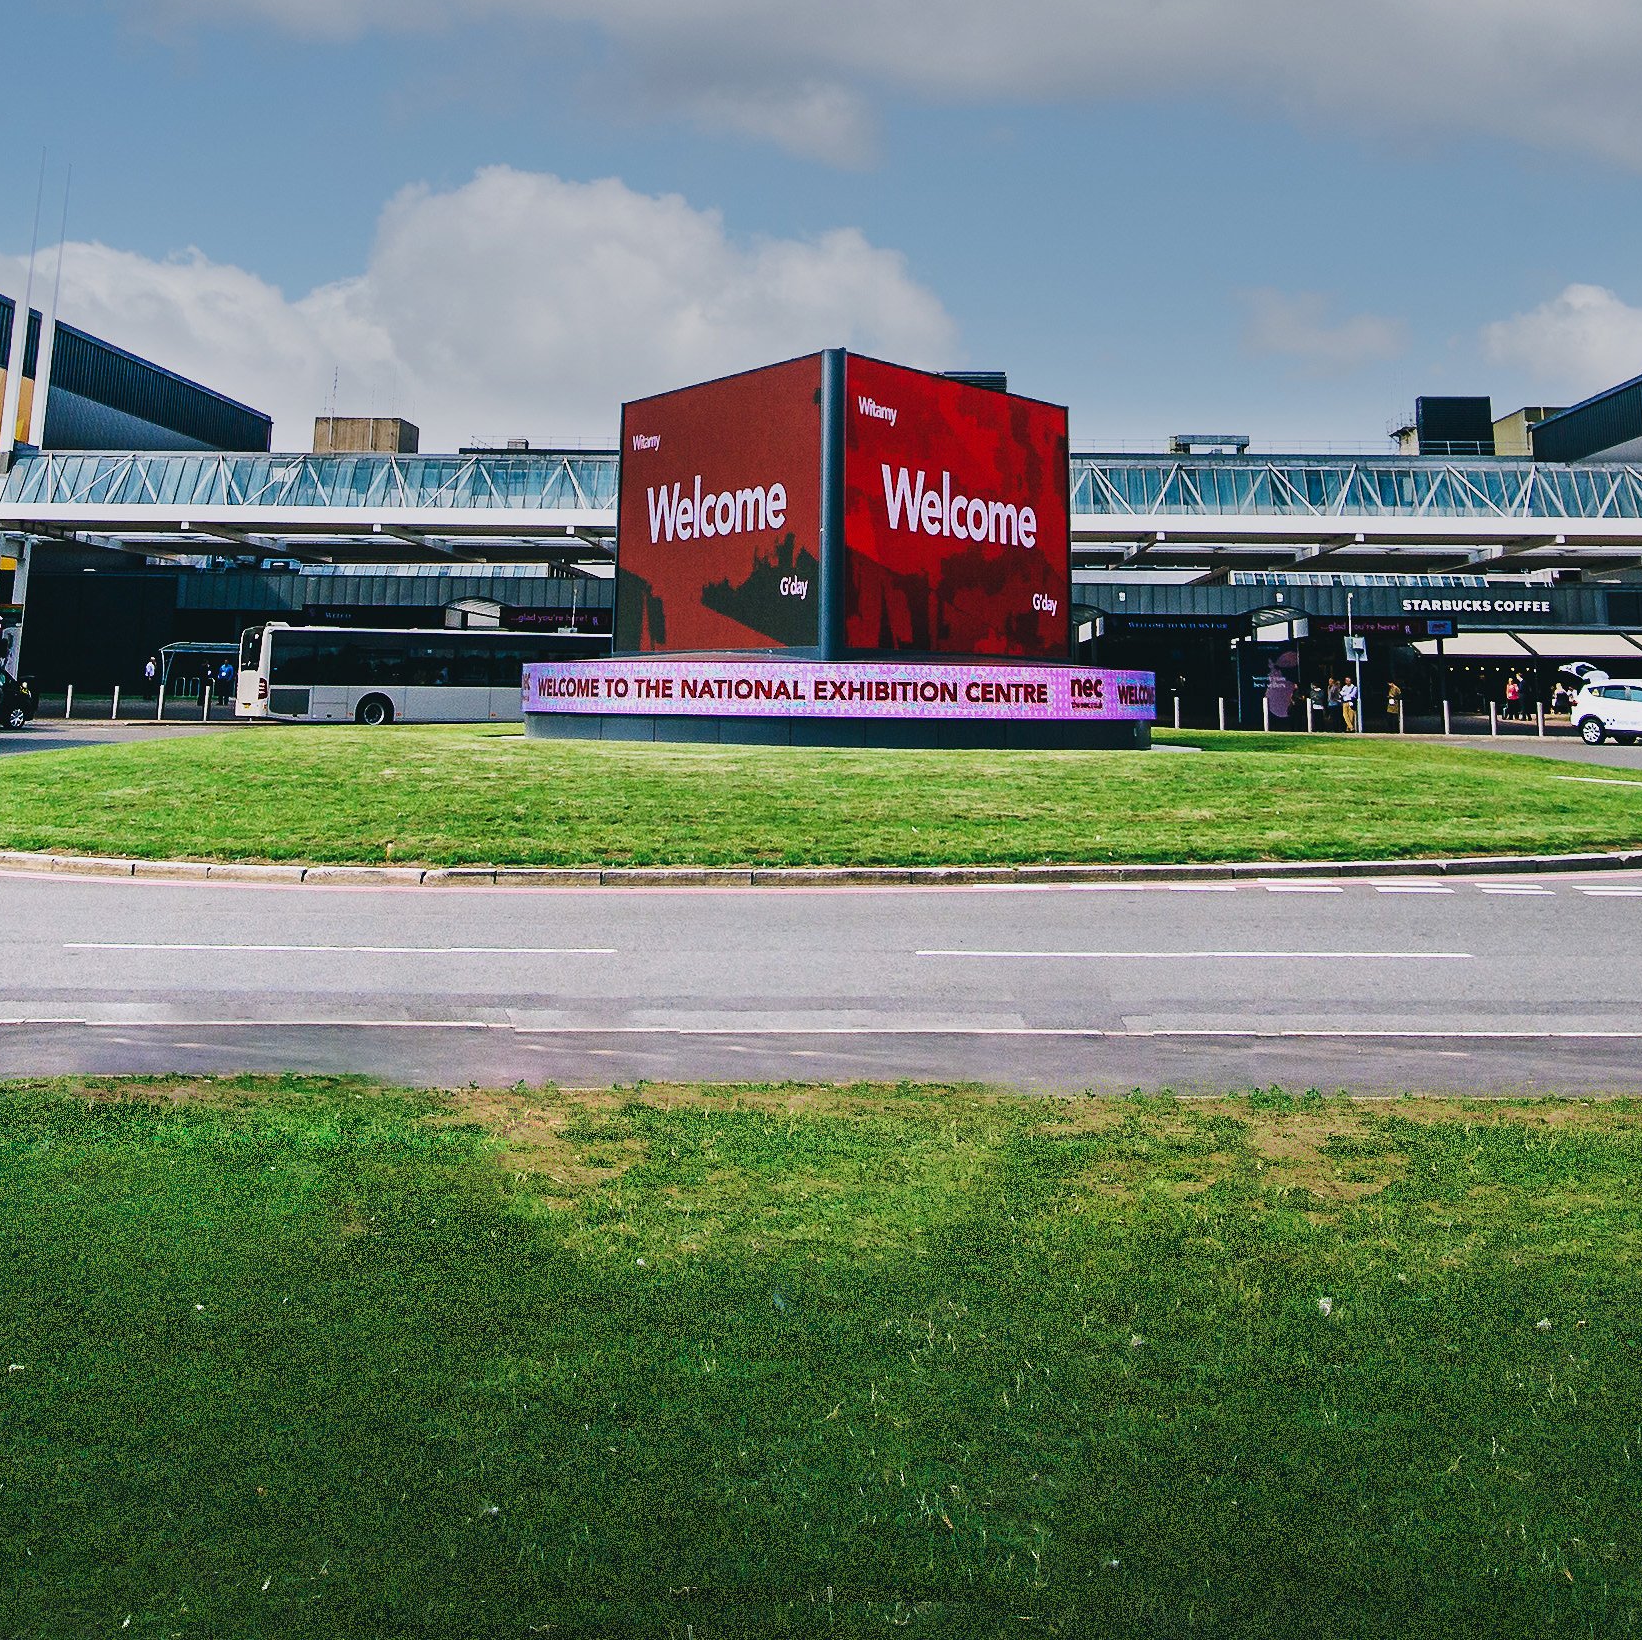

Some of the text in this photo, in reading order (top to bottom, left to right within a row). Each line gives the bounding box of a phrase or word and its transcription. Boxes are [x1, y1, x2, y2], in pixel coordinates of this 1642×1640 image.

[858, 396, 897, 427] Witamy
[632, 434, 661, 451] Witamy
[647, 475, 787, 544] Welcome
[882, 463, 1037, 548] Welcome
[779, 575, 808, 599] G'day
[1033, 593, 1058, 617] G'day
[1402, 599, 1550, 612] STARBUCKS COFFEE
[538, 677, 599, 697] WELCOME
[605, 678, 629, 698] TO
[634, 678, 673, 698] THE
[681, 679, 806, 700] NATIONAL
[814, 680, 958, 703] EXHIBITION
[965, 682, 1048, 703] CENTRE
[1070, 678, 1103, 698] nec
